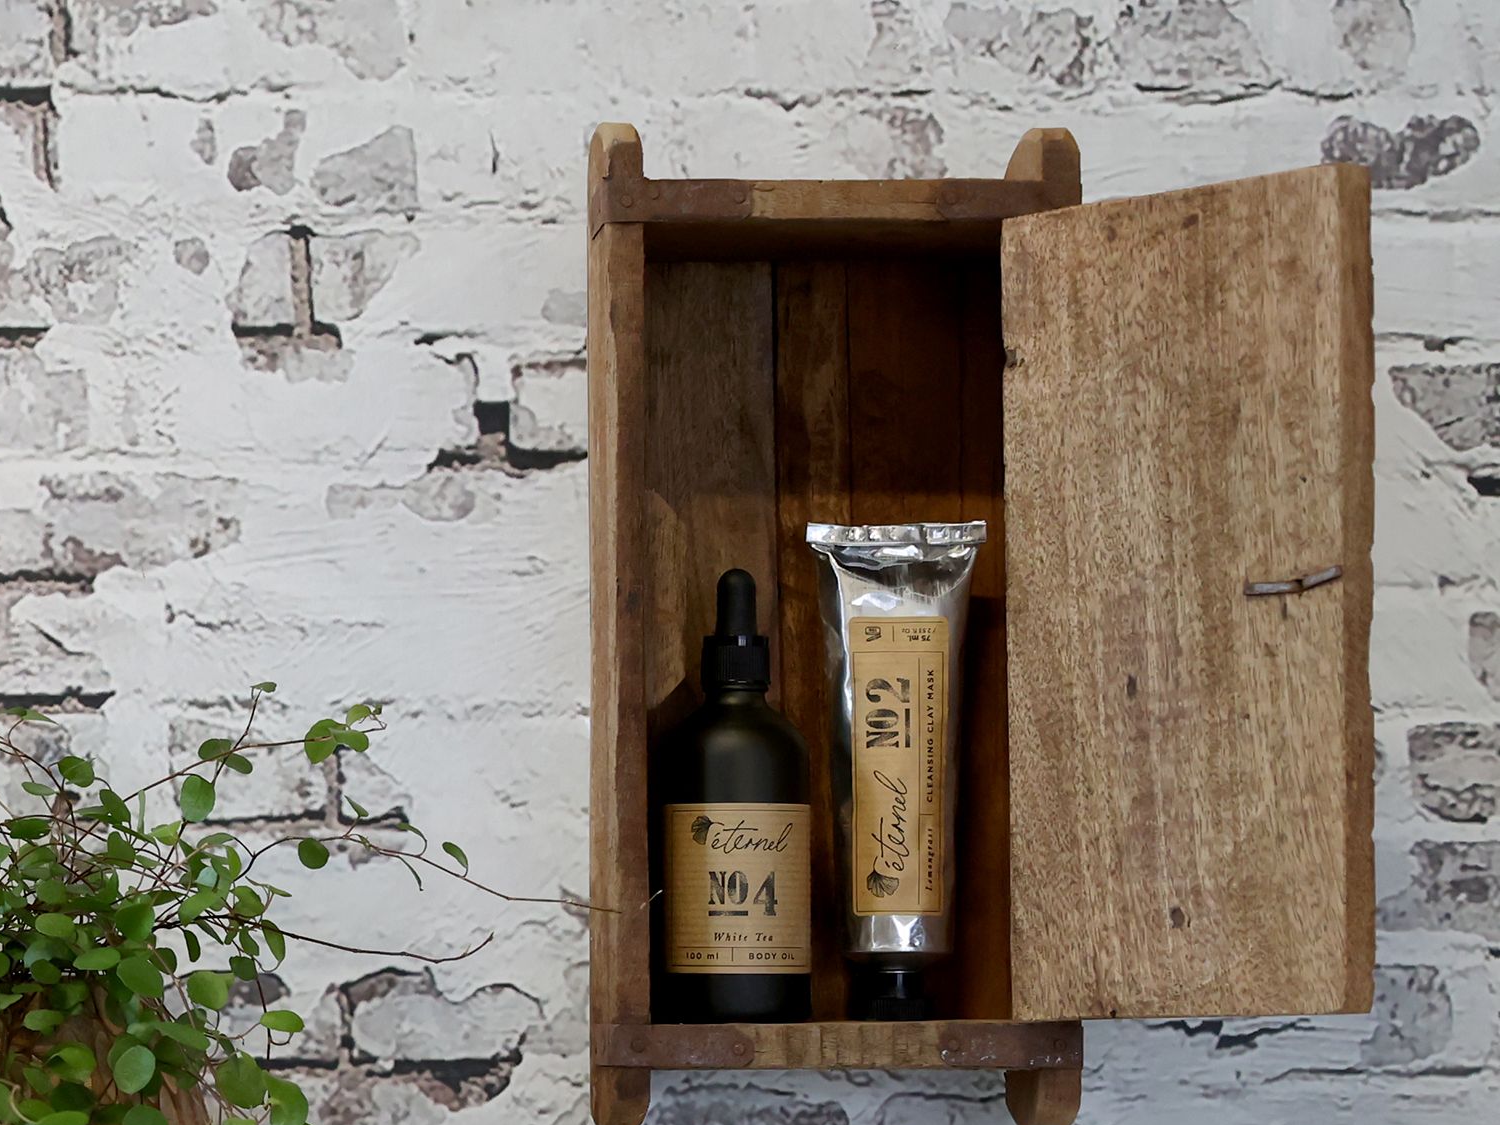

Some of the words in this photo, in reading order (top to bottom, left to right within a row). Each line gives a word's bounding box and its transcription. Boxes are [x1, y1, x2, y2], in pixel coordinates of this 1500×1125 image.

[921, 634, 931, 642] 75
[926, 669, 934, 700] MASK
[926, 705, 934, 733] CLAY
[926, 738, 934, 803] CLEANSING
[925, 828, 935, 891] Lemongrass
[713, 932, 748, 942] White
[755, 932, 774, 942] Tea
[685, 952, 702, 960] 100
[706, 952, 719, 960] ml
[748, 952, 777, 960] BODY
[781, 952, 795, 960] OIL
